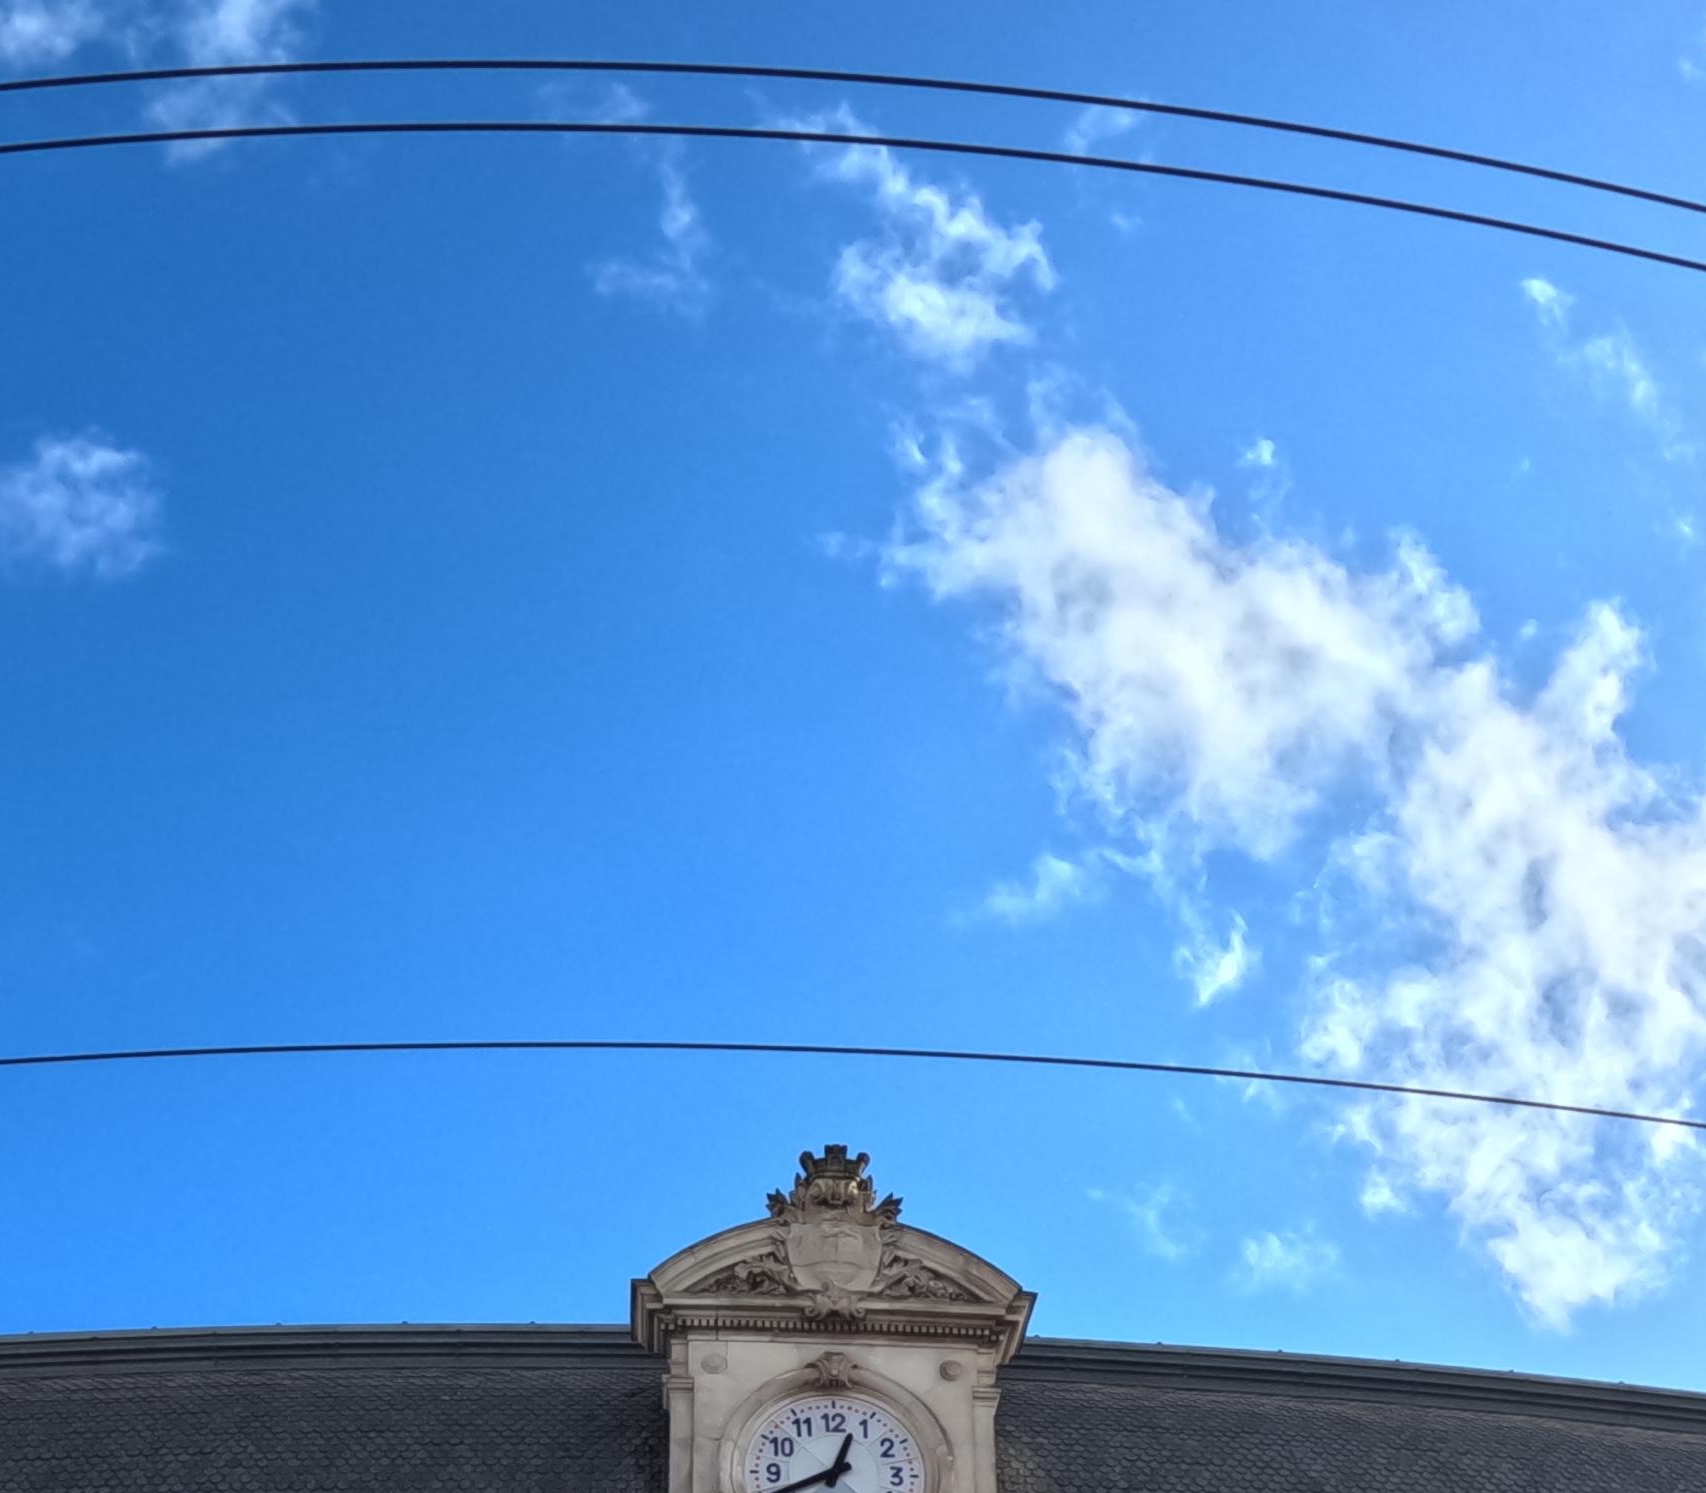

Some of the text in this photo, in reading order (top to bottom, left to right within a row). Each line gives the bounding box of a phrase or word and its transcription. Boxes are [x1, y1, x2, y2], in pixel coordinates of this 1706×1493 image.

[792, 1417, 813, 1437] 11
[820, 1413, 846, 1433] 12
[859, 1419, 869, 1439] 1
[769, 1437, 794, 1457] 10
[880, 1438, 895, 1458] 2
[766, 1463, 782, 1483] 9
[890, 1466, 904, 1487] 3
